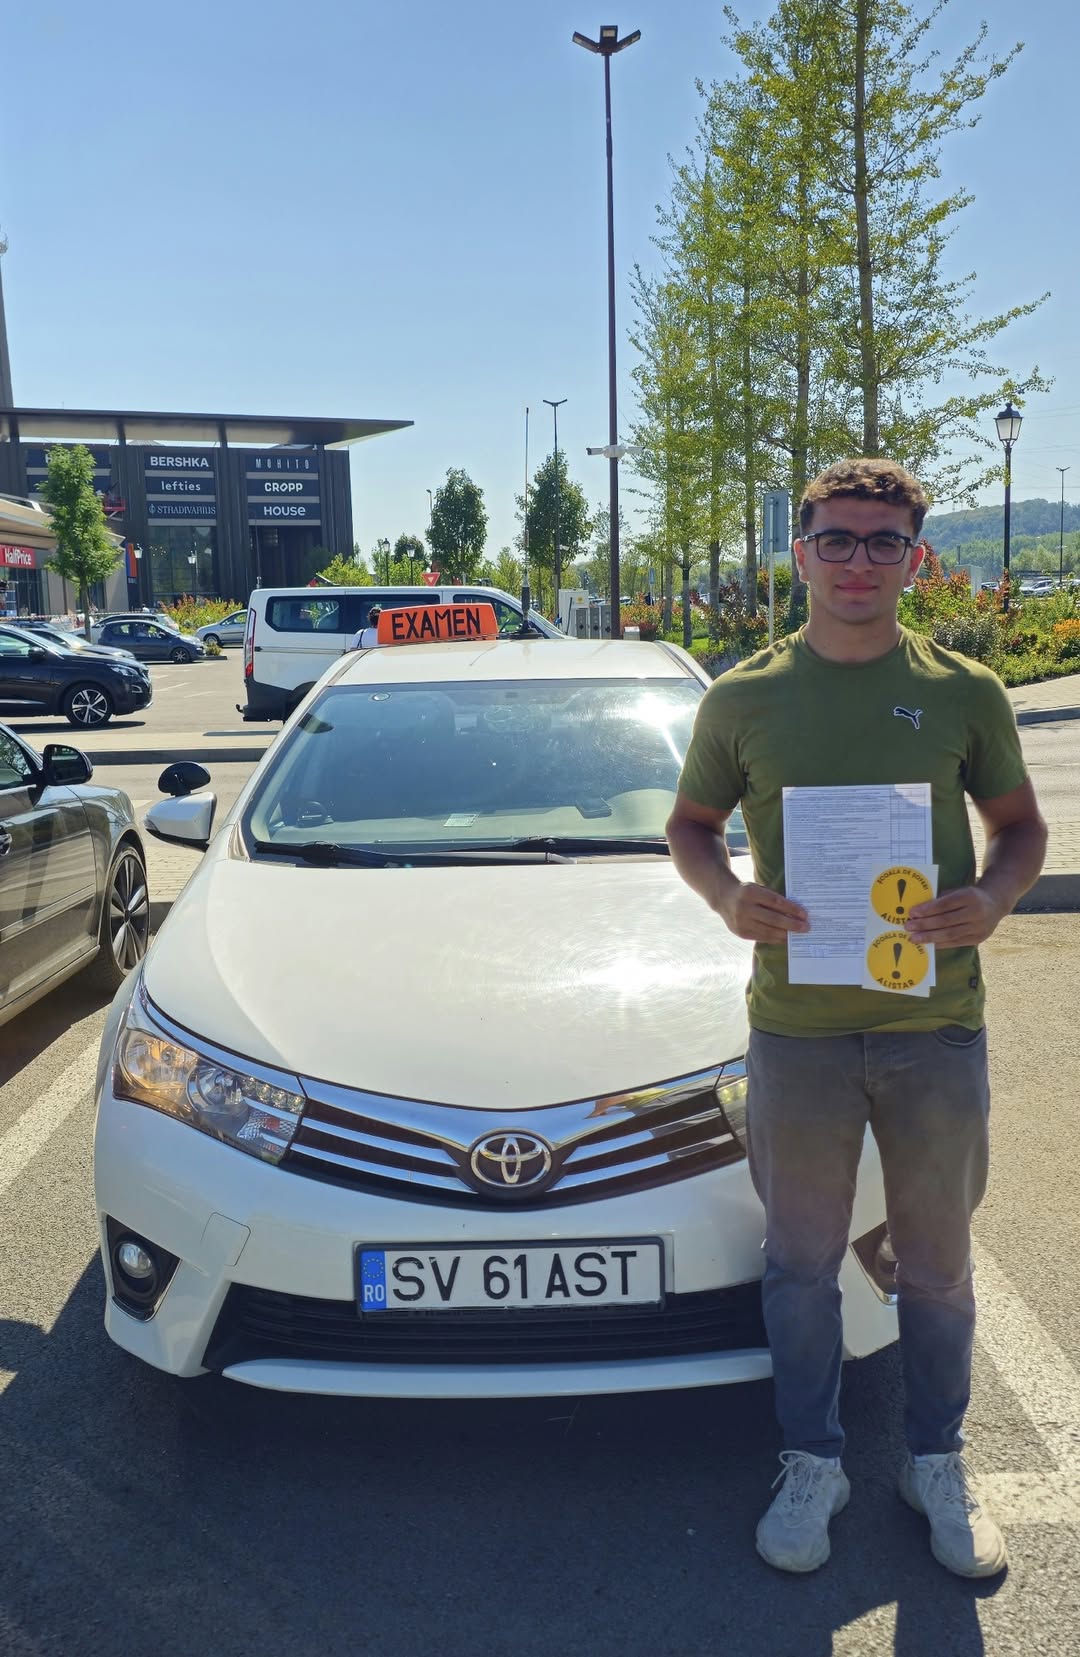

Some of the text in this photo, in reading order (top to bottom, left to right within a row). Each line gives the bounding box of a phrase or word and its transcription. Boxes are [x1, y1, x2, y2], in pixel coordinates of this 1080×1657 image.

[150, 456, 209, 468] BERSHKA
[255, 458, 310, 470] MOHITO
[161, 481, 201, 491] lefties
[264, 482, 303, 492] CROPP
[157, 505, 216, 515] STRADIVARIUS
[4, 547, 32, 566] HalfPrice
[391, 608, 481, 640] EXAMEN
[876, 977, 915, 989] ALISTAR
[391, 1250, 638, 1302] SV 61 AST
[363, 1284, 385, 1303] RO
